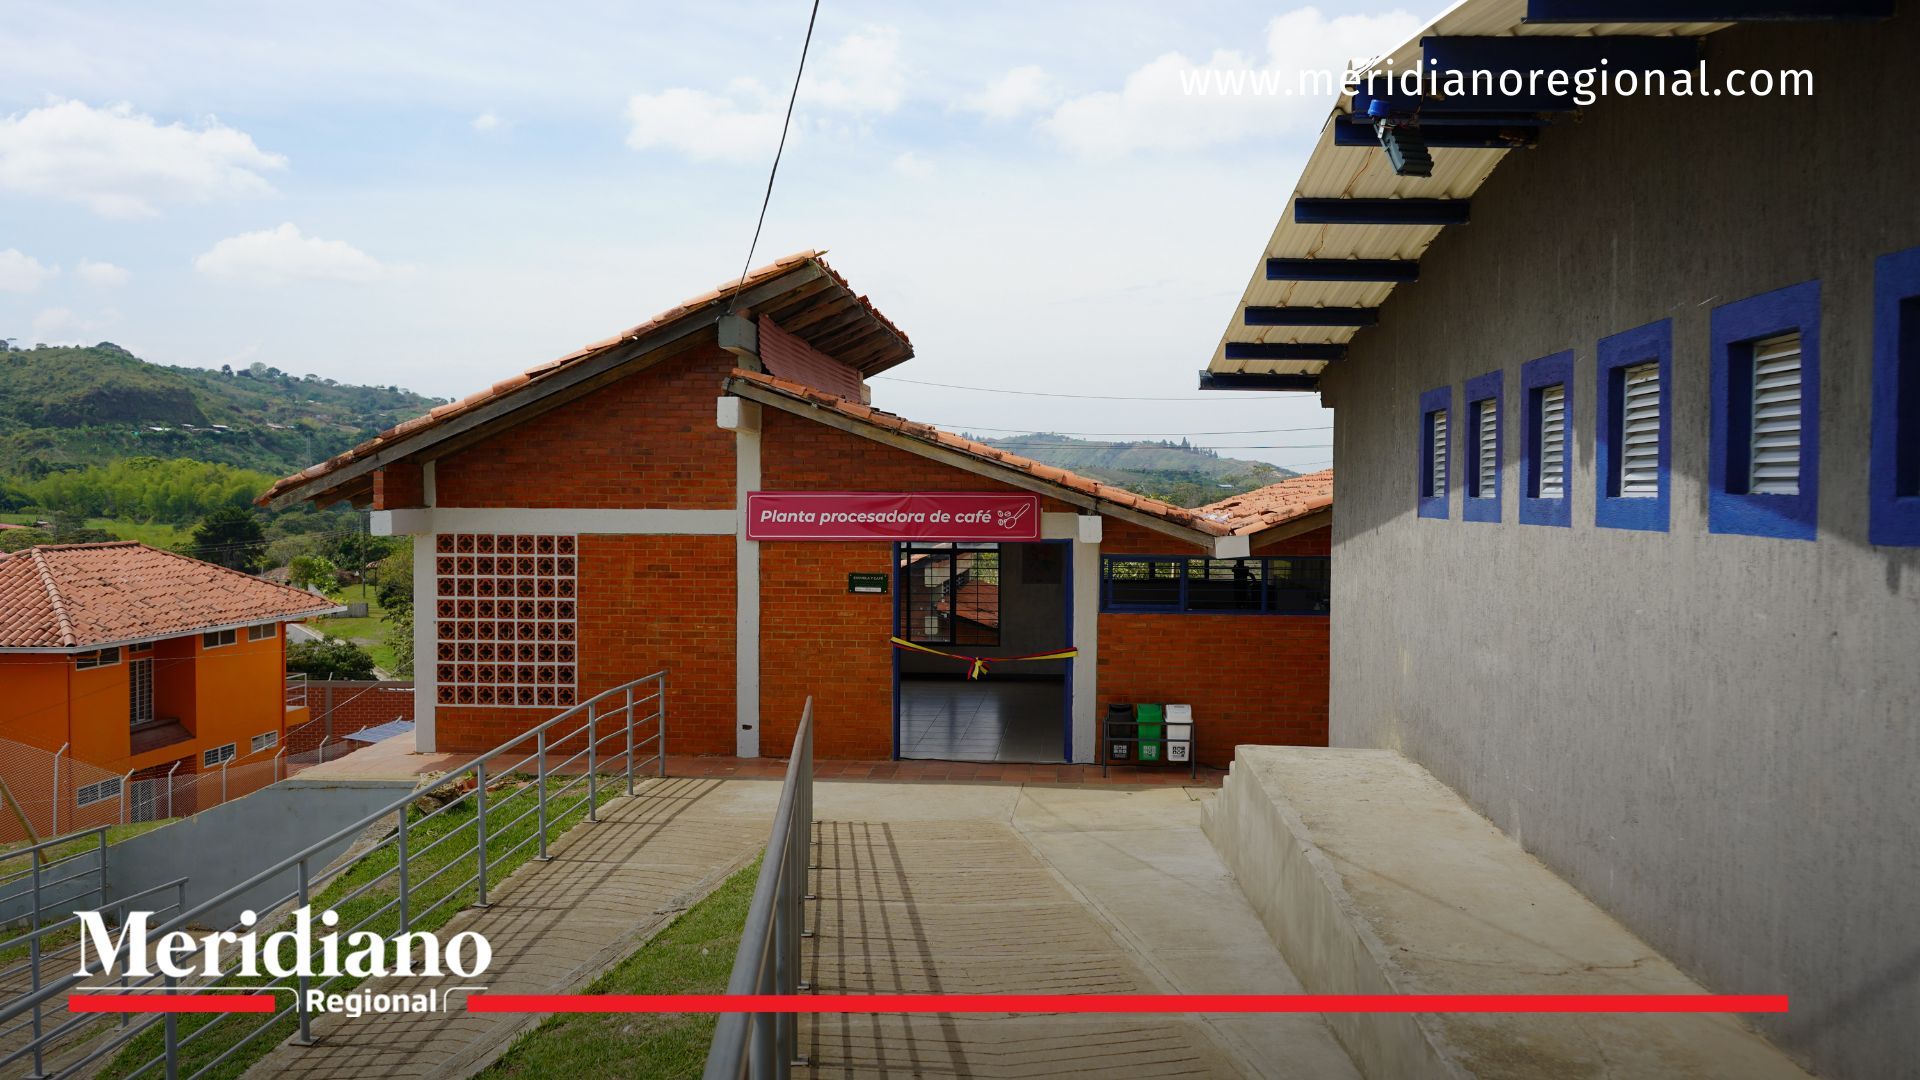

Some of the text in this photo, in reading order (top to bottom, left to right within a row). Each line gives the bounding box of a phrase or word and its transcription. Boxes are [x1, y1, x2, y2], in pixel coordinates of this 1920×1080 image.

[760, 508, 992, 526] Planta procesadora de café
